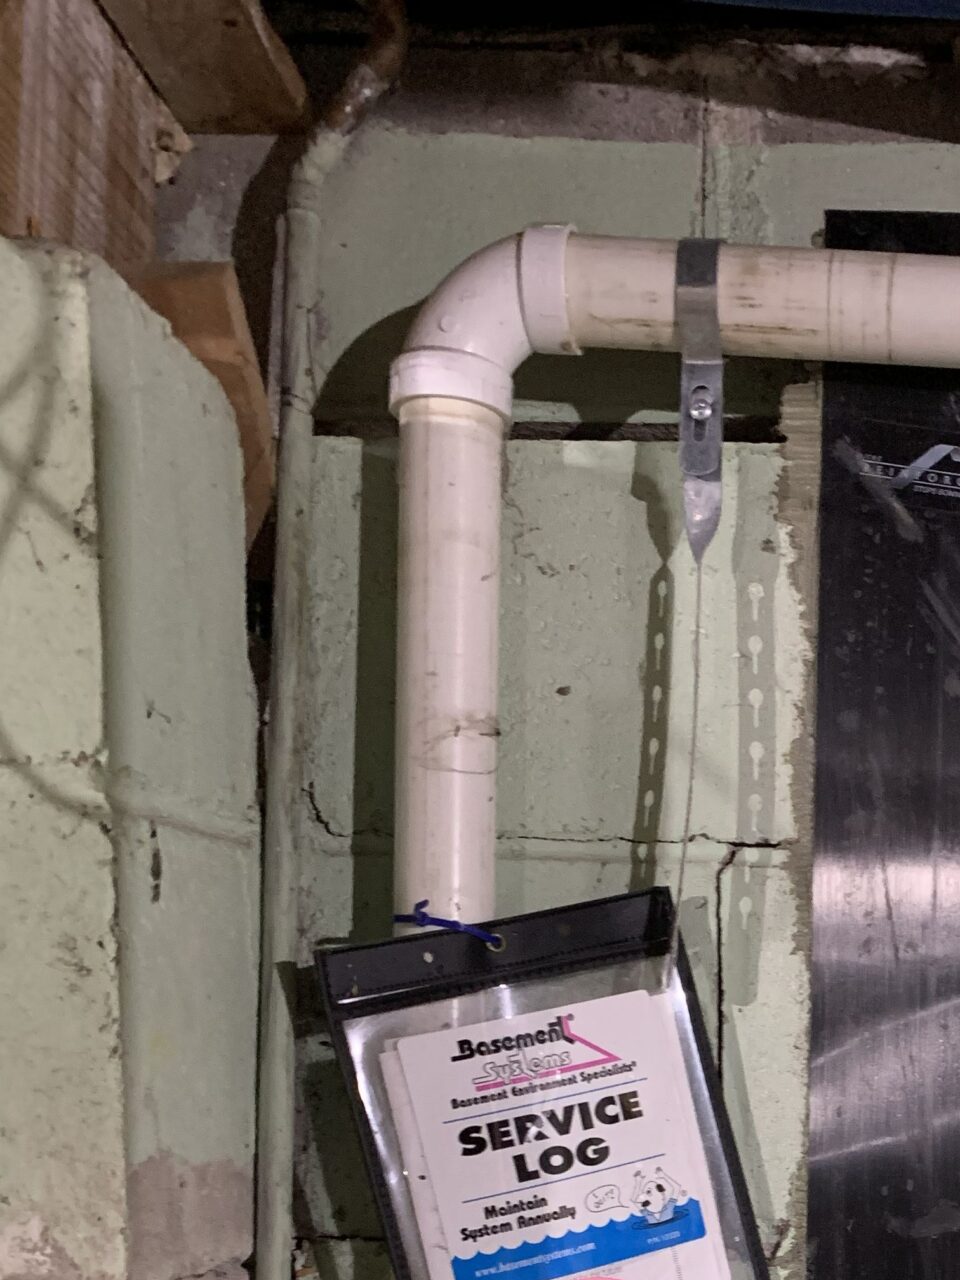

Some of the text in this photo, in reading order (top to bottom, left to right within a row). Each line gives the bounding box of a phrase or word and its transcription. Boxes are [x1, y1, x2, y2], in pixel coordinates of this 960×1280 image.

[451, 1016, 576, 1062] Basement
[472, 1048, 572, 1085] Systems
[451, 1090, 508, 1109] Basement
[511, 1076, 577, 1096] Environment
[458, 1090, 643, 1156] SERVICE
[513, 1137, 610, 1183] LOG
[460, 1205, 576, 1242] System Annually
[484, 1195, 548, 1219] Maintain
